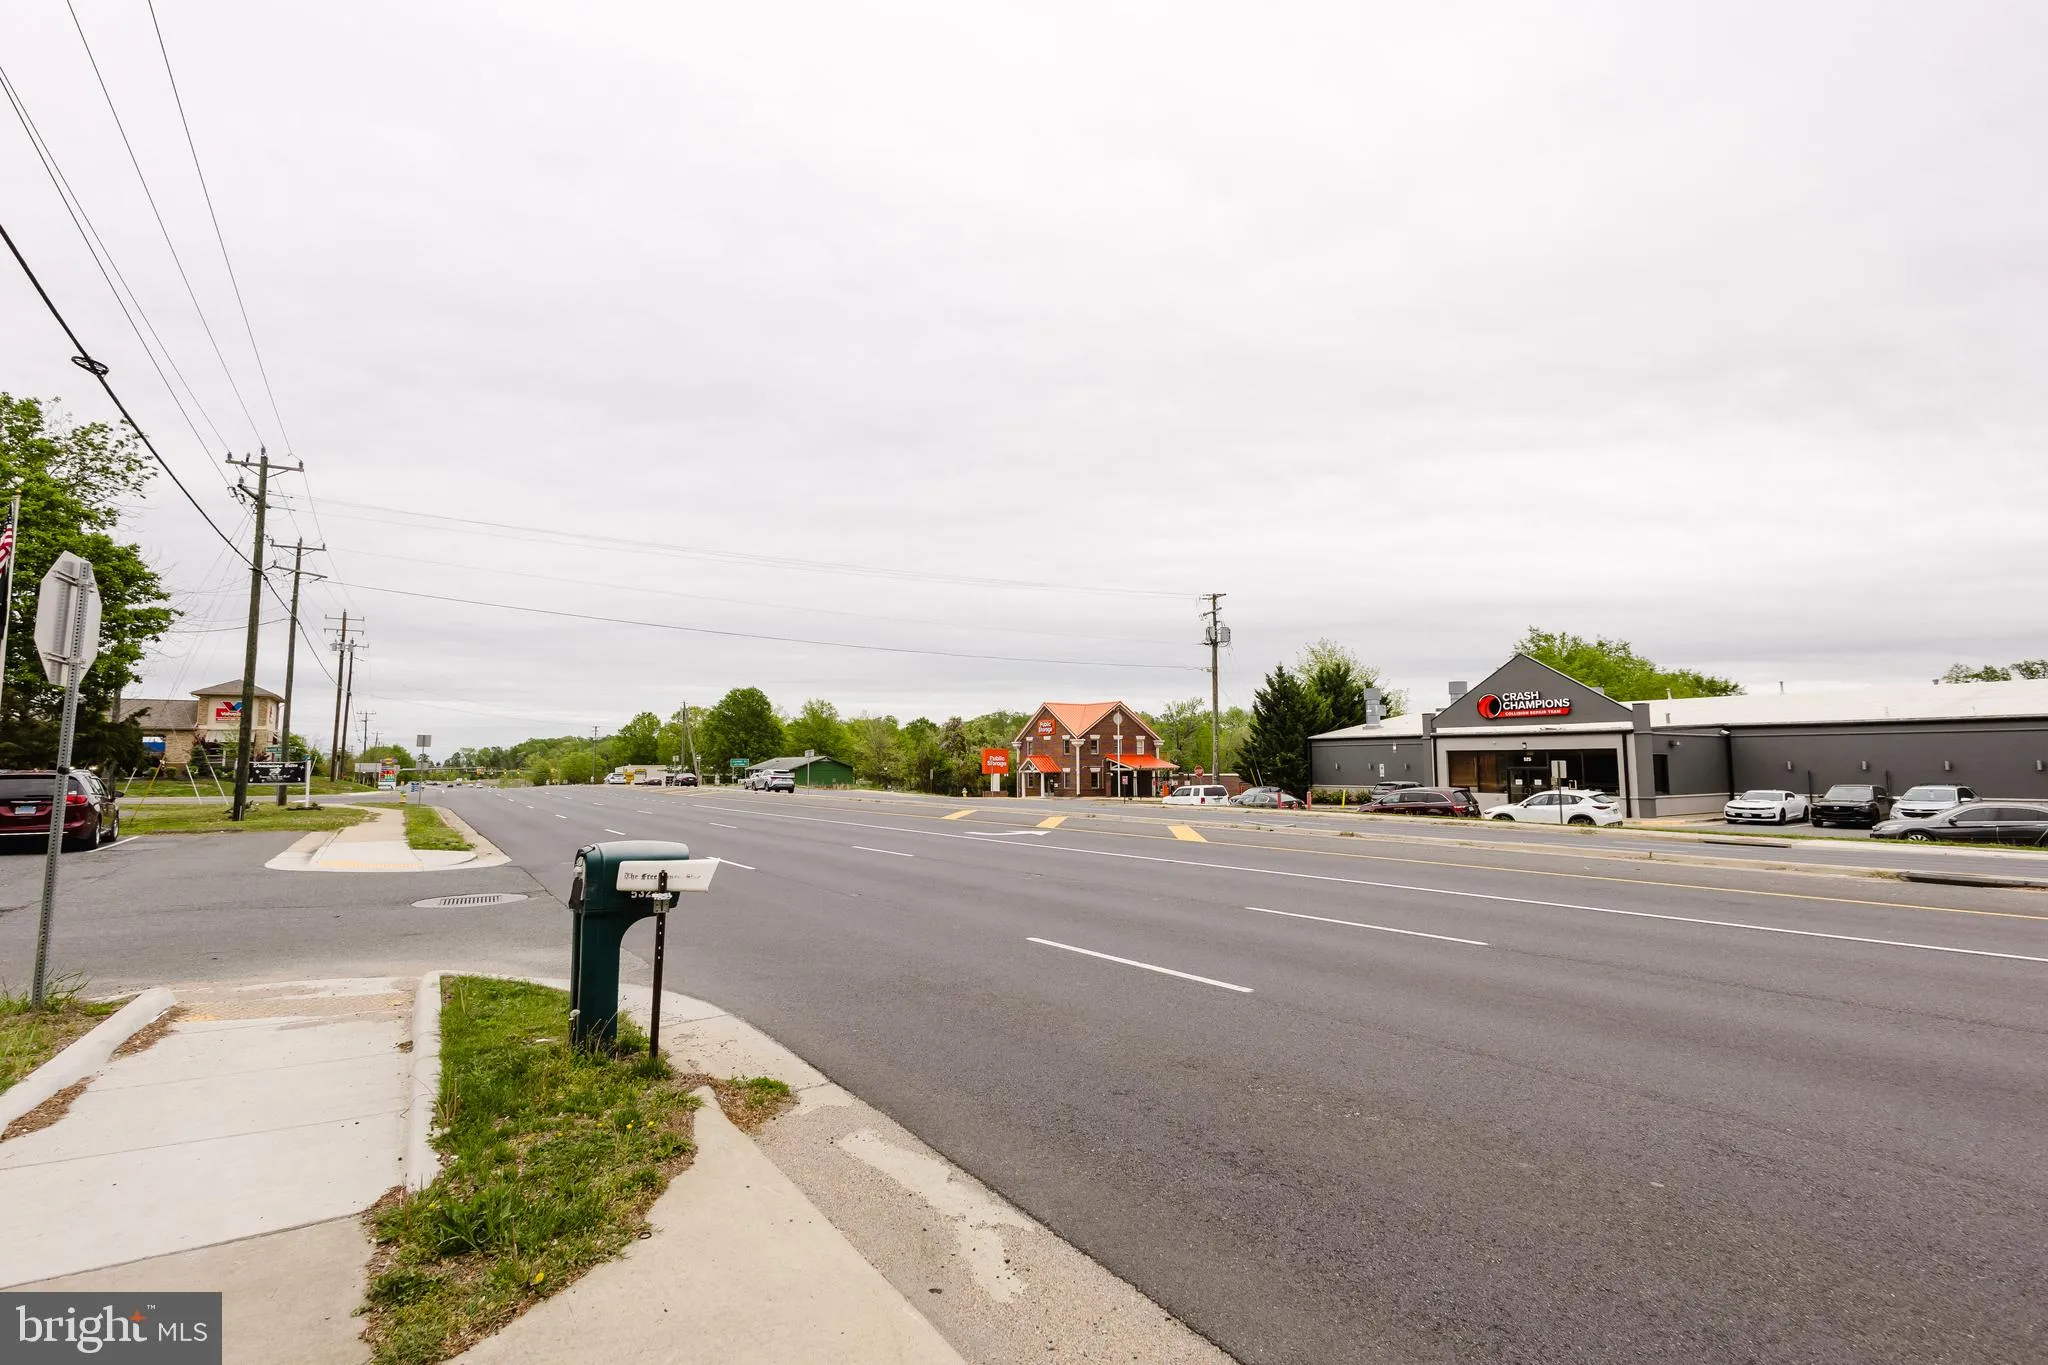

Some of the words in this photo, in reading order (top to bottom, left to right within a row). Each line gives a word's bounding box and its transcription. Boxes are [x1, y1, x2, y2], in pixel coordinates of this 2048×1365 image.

[1502, 691, 1539, 701] CRASH
[1502, 698, 1570, 710] CHAMPIONS
[624, 872, 638, 880] The
